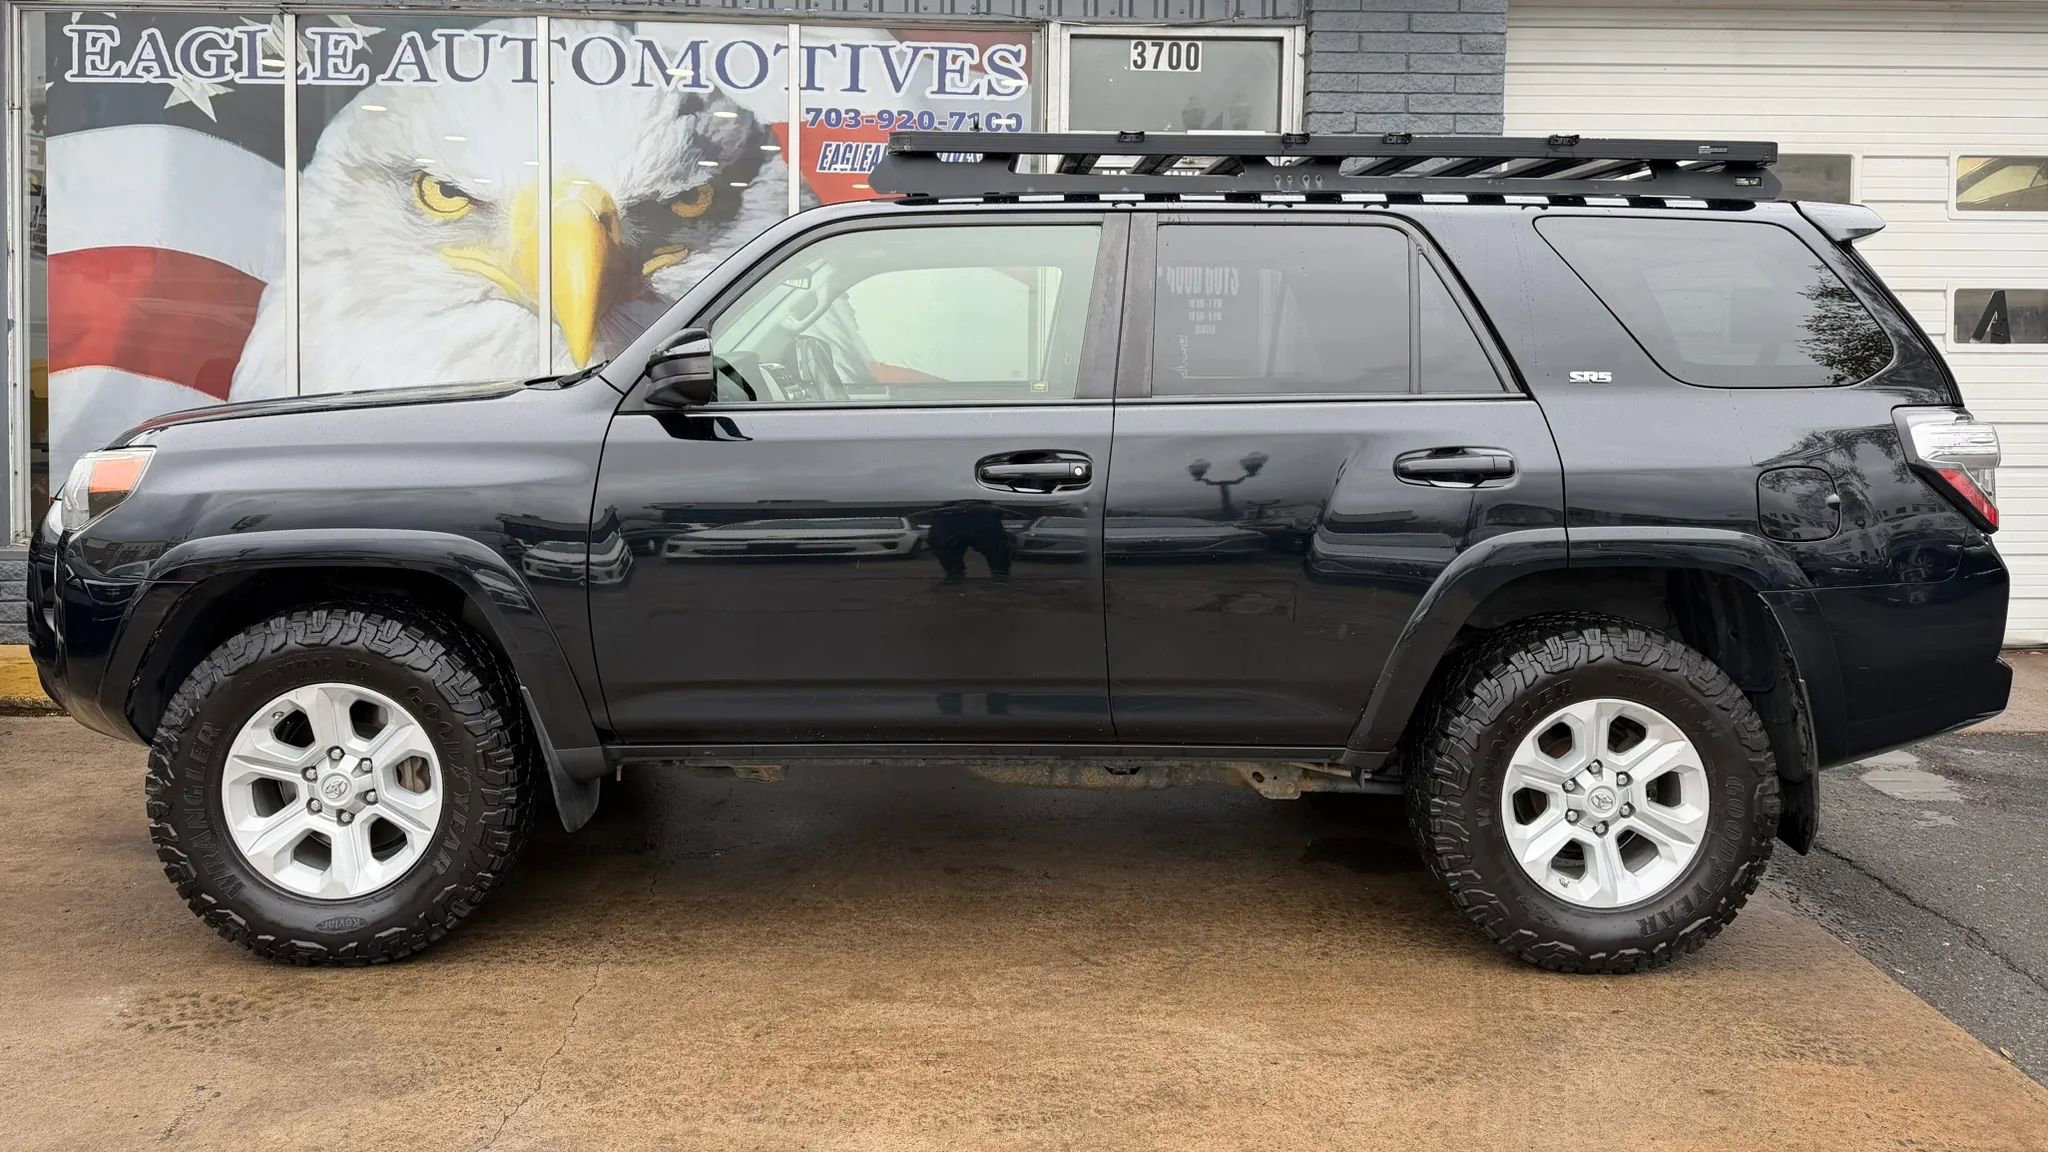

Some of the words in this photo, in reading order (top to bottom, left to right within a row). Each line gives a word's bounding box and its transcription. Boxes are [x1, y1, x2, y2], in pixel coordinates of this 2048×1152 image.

[64, 25, 368, 84] EAGLE
[377, 29, 1028, 100] AUTOMOTIVES
[1132, 40, 1200, 71] 3700
[805, 107, 1023, 133] 703-920-7100
[1569, 370, 1612, 383] SR5
[185, 720, 248, 899] WRANGLER
